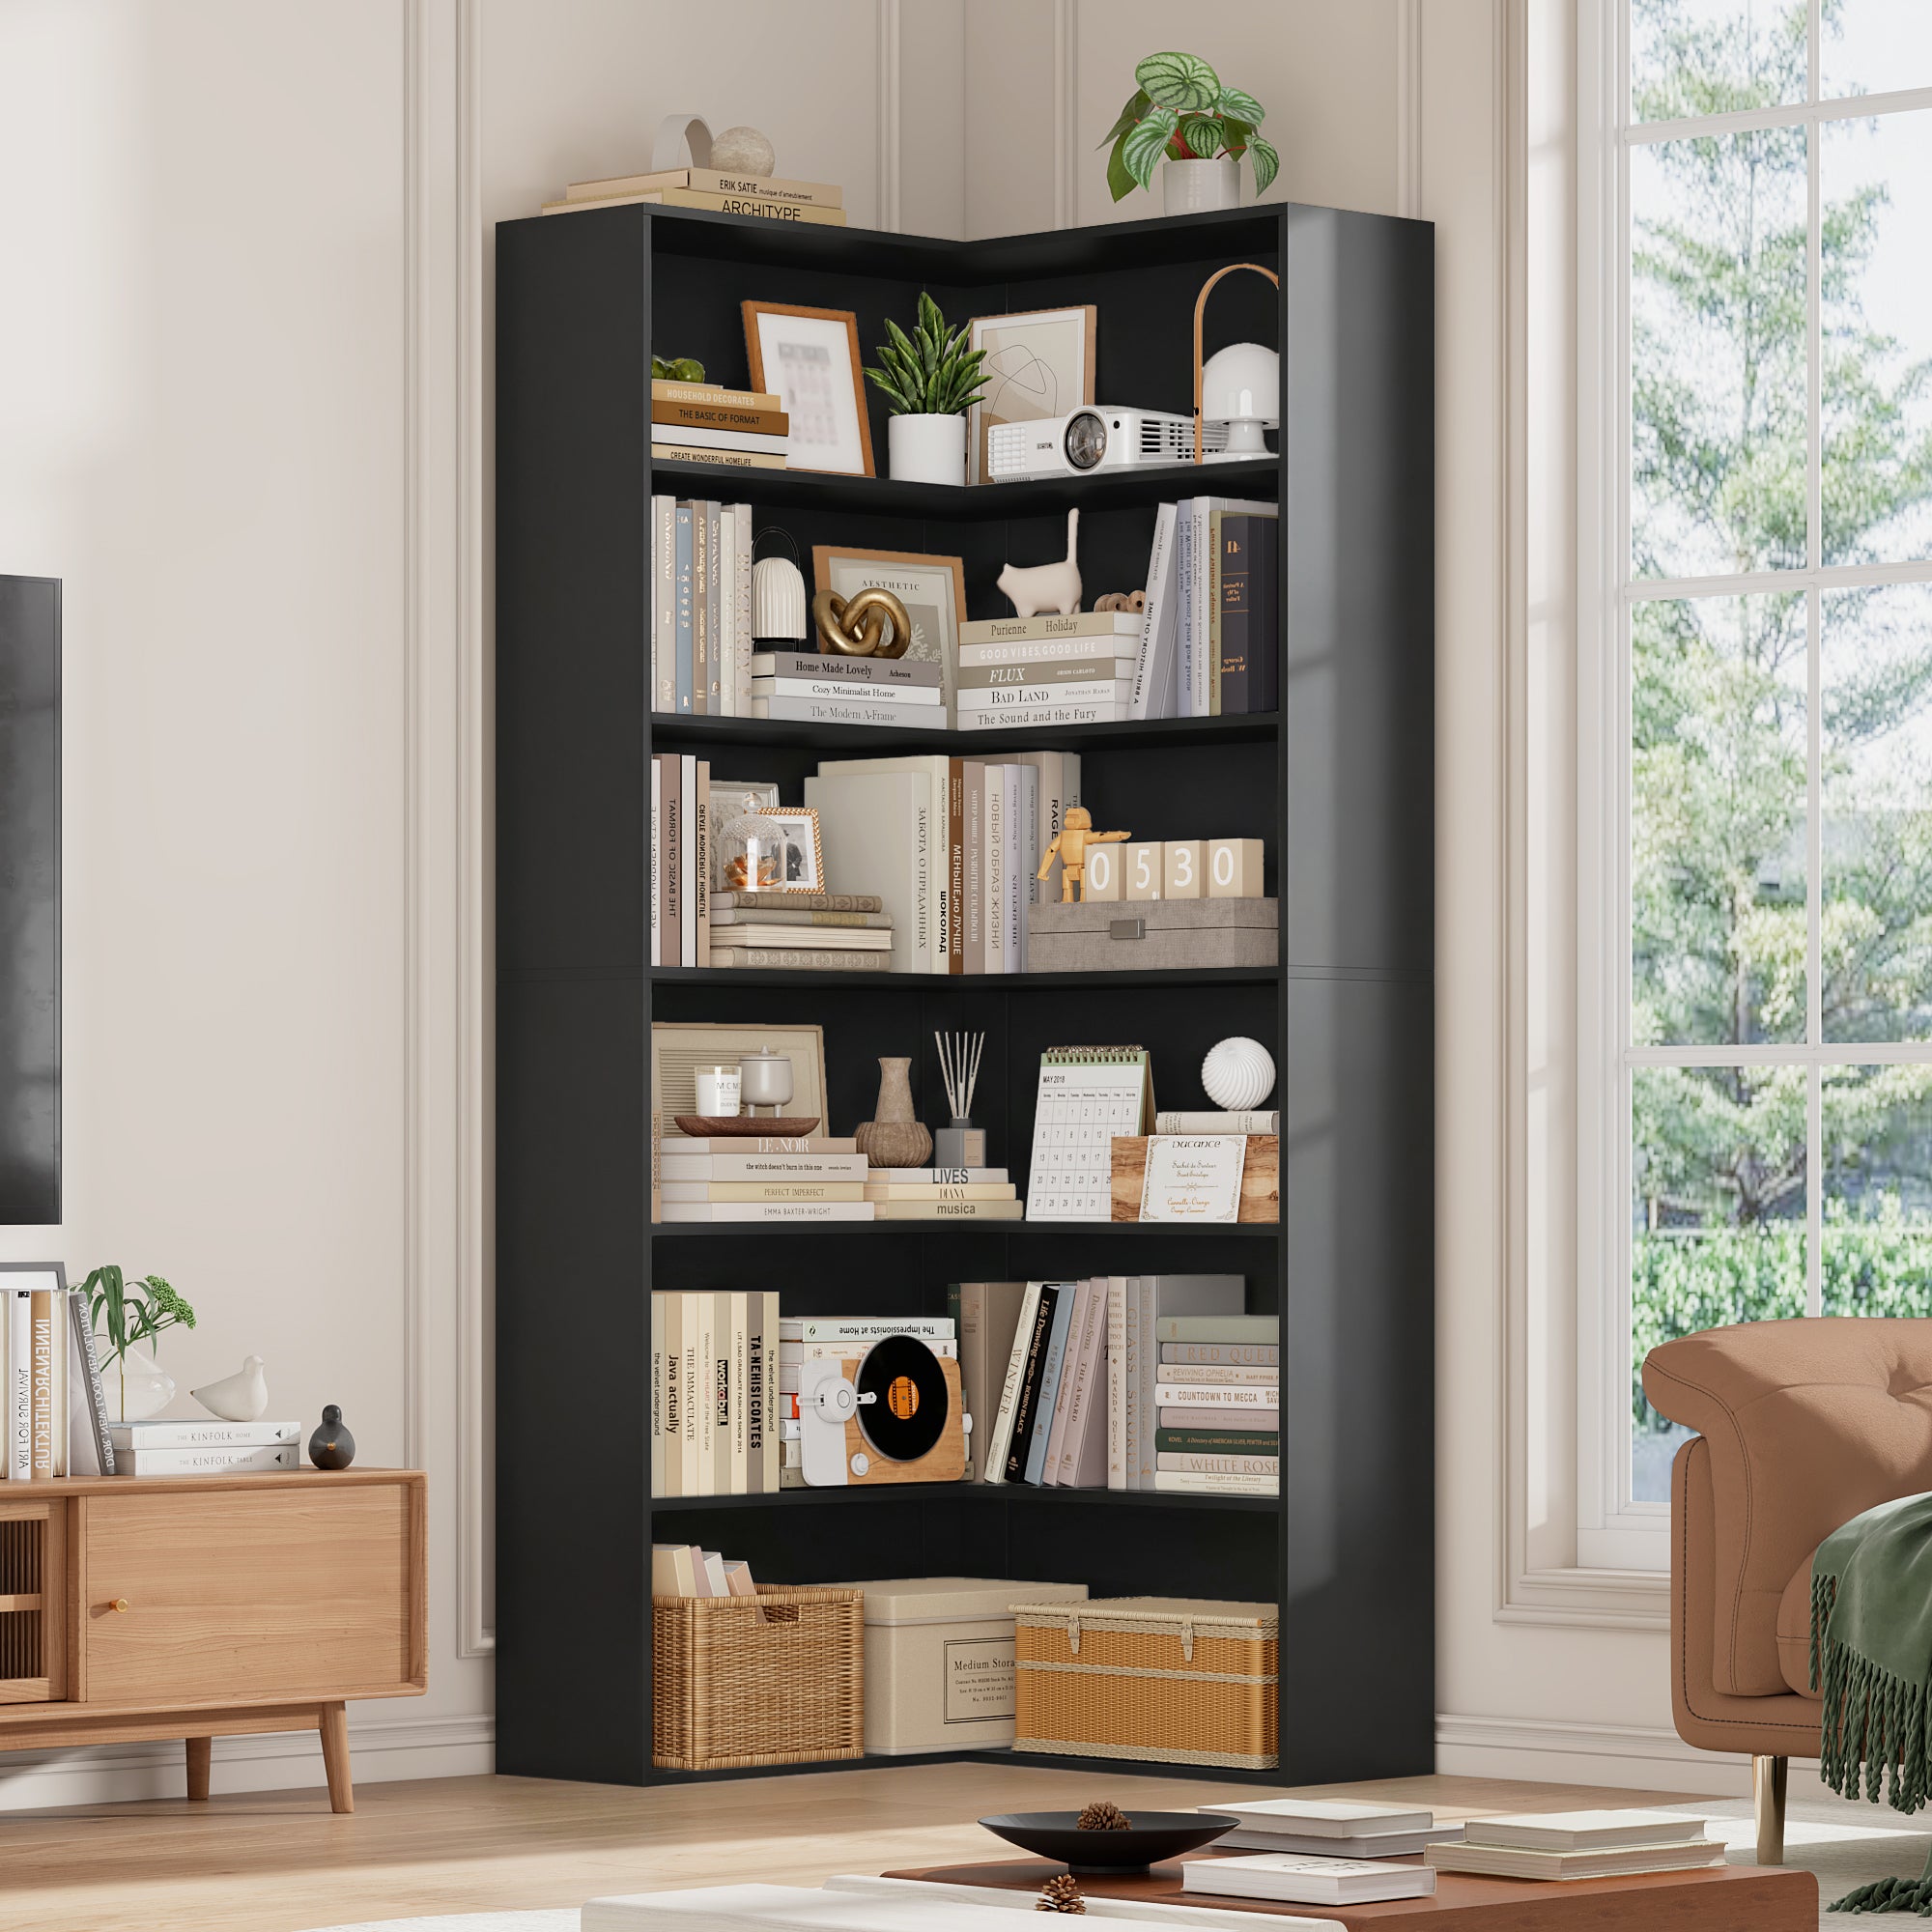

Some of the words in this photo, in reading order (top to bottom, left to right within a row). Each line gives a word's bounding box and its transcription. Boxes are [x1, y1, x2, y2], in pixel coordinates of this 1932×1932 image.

[720, 179, 735, 191] ERIK
[737, 182, 757, 194] SATIE
[722, 199, 801, 221] ARCHITYPE
[667, 388, 711, 402] HOUSEHOLD
[713, 392, 755, 407] DECORATES
[678, 409, 694, 419] THE
[695, 411, 716, 421] BASIC
[718, 412, 727, 422] OF
[729, 413, 760, 425] FORMAT
[670, 451, 691, 461] CREATE
[692, 453, 724, 464] WONDERFUL
[725, 456, 752, 466] HOMELIFE
[664, 512, 673, 580] UNBOUND
[696, 547, 706, 573] Young
[736, 554, 751, 623] BLACK
[862, 580, 921, 591] AESTHETIC
[991, 624, 1027, 637] Purienne
[1045, 619, 1078, 634] Holiday
[736, 631, 751, 677] KEY
[980, 648, 1009, 660] GOOD
[1042, 644, 1071, 656] GOOD
[1074, 641, 1096, 653] LIFE
[795, 661, 820, 672] Home
[821, 662, 844, 675] Made
[846, 664, 872, 679] Lovely
[889, 668, 912, 678] Acheson
[989, 668, 1026, 683] FLUX
[812, 685, 831, 696] Cozy
[833, 686, 870, 696] Minimalist
[872, 688, 896, 698] Home
[810, 705, 827, 718] The
[829, 706, 861, 720] Modern
[863, 708, 896, 722] A-Frame
[978, 714, 996, 725] The
[999, 710, 1029, 724] Sound
[1033, 710, 1051, 722] and
[1055, 708, 1070, 721] the
[1074, 708, 1097, 721] Fury
[990, 793, 1001, 844] НОВЫЙ
[1051, 799, 1060, 839] RAGE
[918, 807, 927, 853] ЗАБОТА
[918, 858, 927, 867] О
[990, 849, 1001, 893] ОБРАЗ
[1090, 851, 1110, 891] 0
[1135, 849, 1151, 890] 5
[1174, 847, 1193, 887] 3
[1213, 847, 1234, 886] 0
[918, 870, 927, 949] ПРЕДАННЫХ
[939, 891, 948, 953] ШОКОЛАД
[990, 897, 1001, 949] ЖИЗНИ
[952, 915, 962, 955] ЛУЧШЕ
[1042, 1075, 1054, 1084] MAY
[1054, 1075, 1065, 1084] 2018
[758, 1138, 774, 1152] LE
[780, 1138, 810, 1152] NOIR
[754, 1162, 767, 1171] witch
[768, 1162, 785, 1171] doesn't
[932, 1168, 969, 1184] LIVES
[764, 1188, 789, 1197] PERFECT
[792, 1188, 825, 1197] IMPERFECT
[937, 1203, 976, 1214] musica
[1039, 1299, 1050, 1318] Life
[1087, 1293, 1100, 1329] DANIELLE
[838, 1326, 859, 1335] Home
[869, 1325, 921, 1336] Impressionists
[922, 1325, 935, 1335] The
[1031, 1319, 1045, 1357] Drawing
[1083, 1329, 1094, 1351] STEEL
[1126, 1308, 1137, 1374] GLASS
[1187, 1346, 1220, 1361] RED
[668, 1354, 679, 1381] Java
[750, 1335, 761, 1398] TA-NEHISI
[1078, 1362, 1088, 1381] THE
[1173, 1368, 1204, 1377] REVIVING
[1206, 1369, 1234, 1378] OPHELIA
[999, 1347, 1023, 1415] WINTER
[717, 1360, 727, 1425] workabull.
[1021, 1384, 1032, 1410] ROBIN
[1178, 1390, 1221, 1402] COUNTDOWN
[1223, 1392, 1232, 1402] TO
[1234, 1392, 1258, 1403] MECCA
[652, 1389, 661, 1435] underground
[666, 1386, 679, 1434] actually
[766, 1386, 775, 1432] underground
[1071, 1385, 1084, 1422] AWARD
[750, 1400, 761, 1449] COATES
[1016, 1409, 1027, 1435] BLACK
[1126, 1390, 1137, 1463] SWORD
[190, 1431, 233, 1441] KINFOLK
[192, 1456, 233, 1466] KINFOLK
[1190, 1458, 1238, 1473] WHITE
[1243, 1460, 1279, 1475] ROSE
[953, 1659, 989, 1671] Medium
[992, 1658, 1015, 1668] Stora
